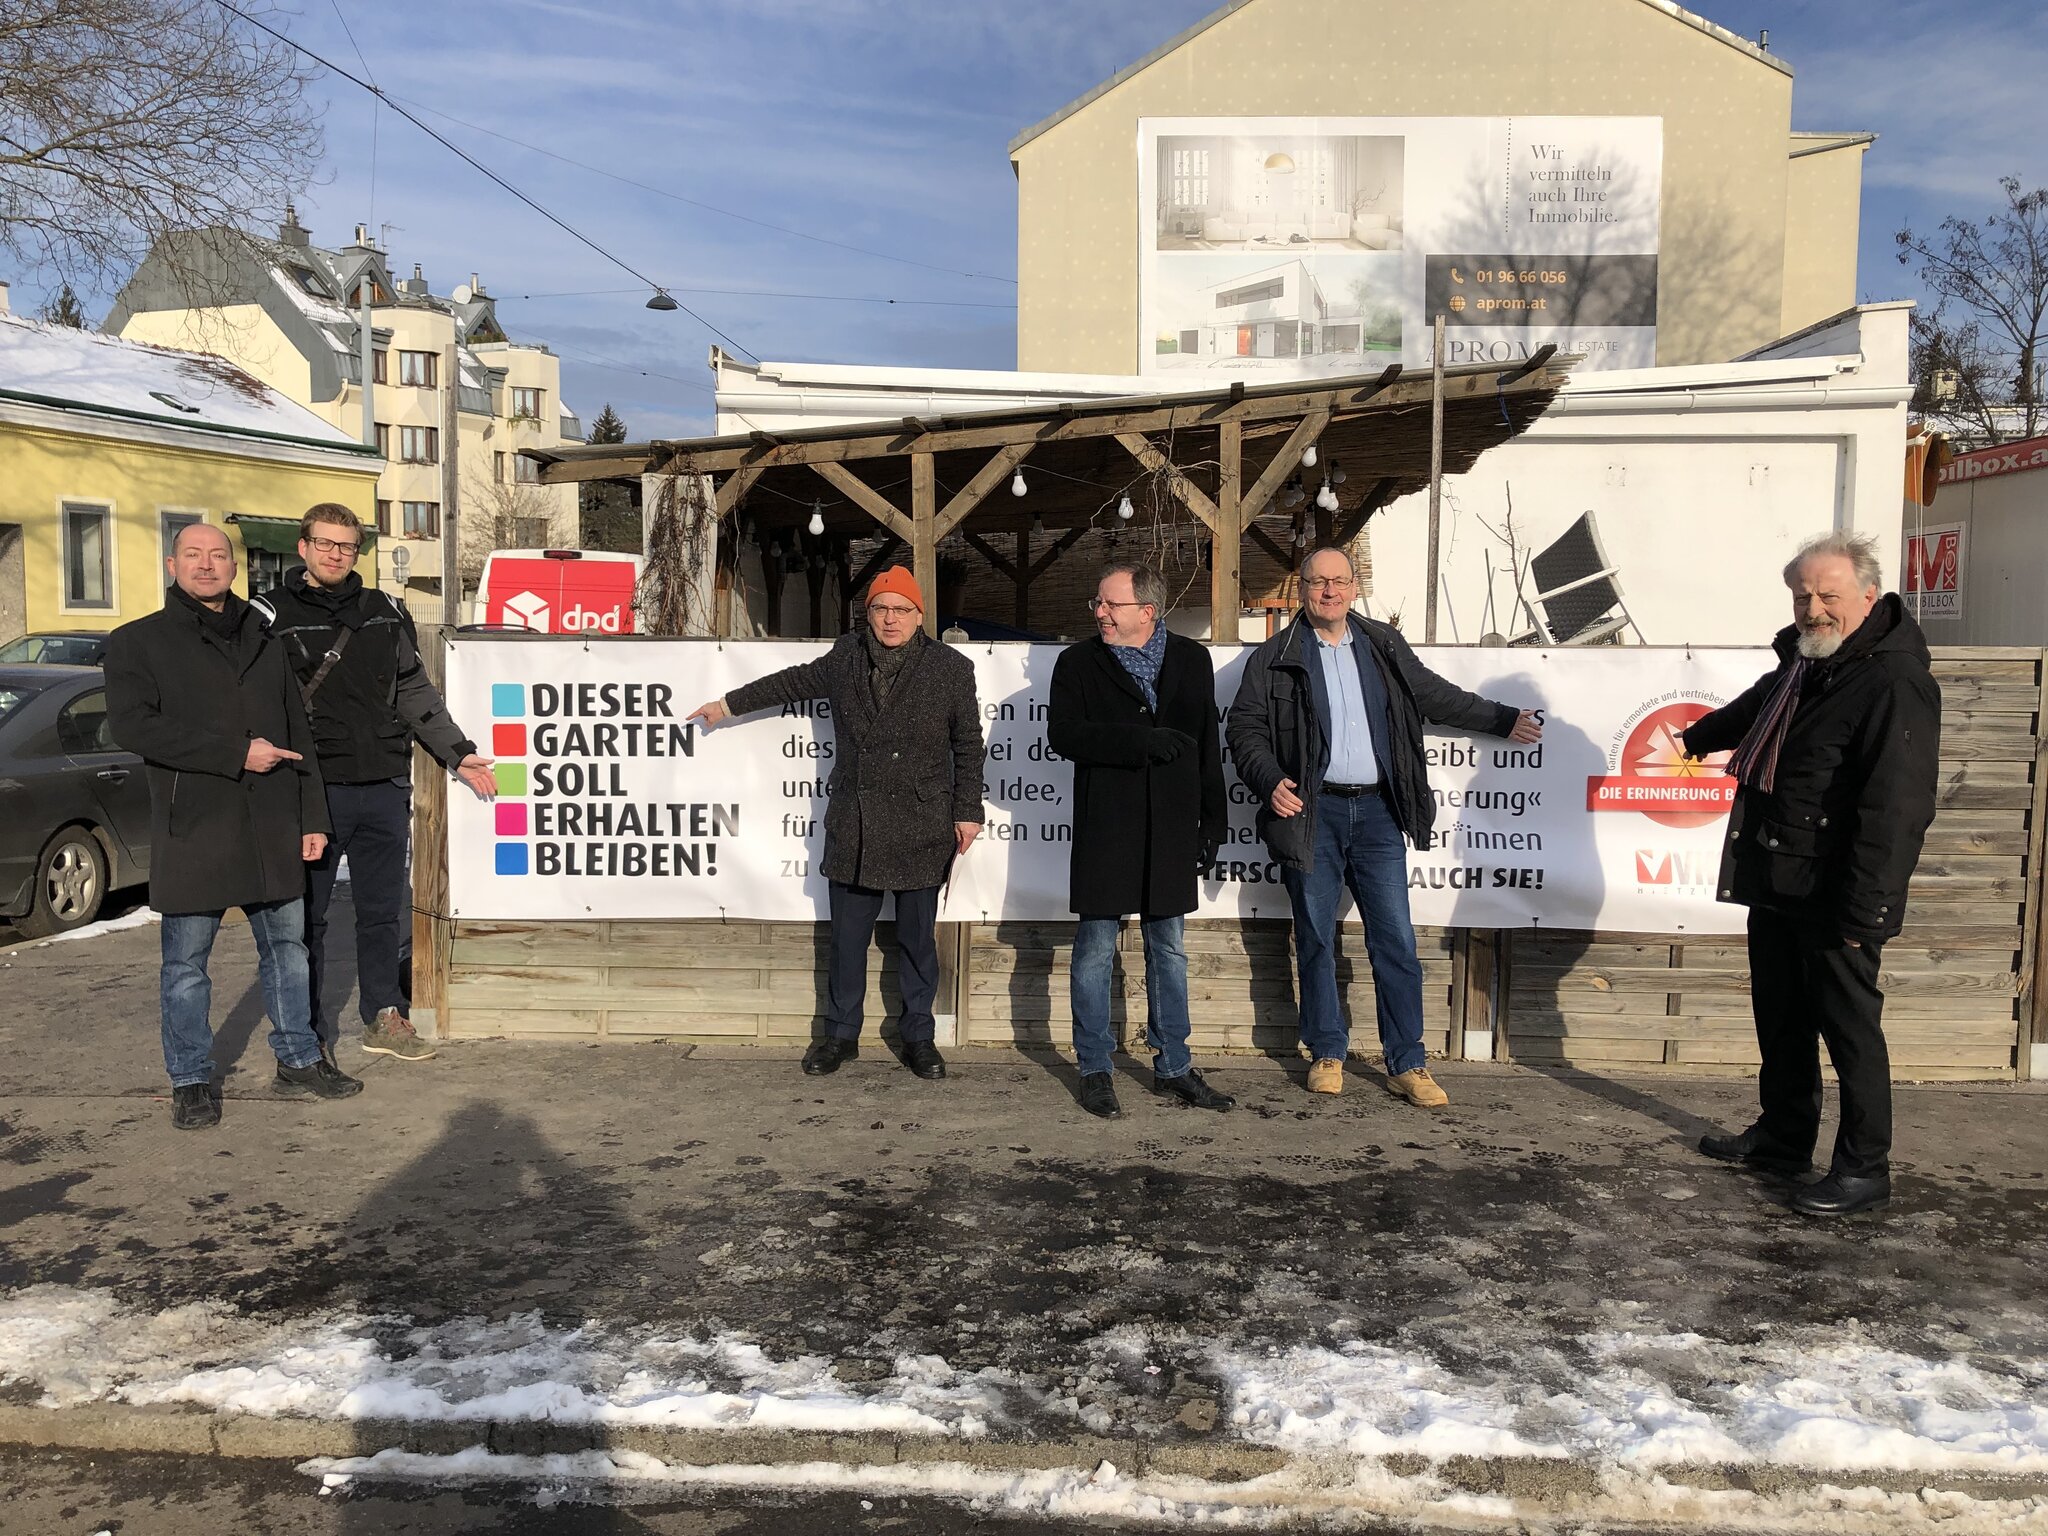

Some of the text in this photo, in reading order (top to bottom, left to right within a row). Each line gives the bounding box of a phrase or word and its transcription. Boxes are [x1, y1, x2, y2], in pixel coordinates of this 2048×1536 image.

[1531, 144, 1564, 160] Wir
[1529, 166, 1612, 181] vermitteln
[1528, 187, 1607, 202] auch Ihre
[1529, 208, 1618, 223] Immobilie.
[1476, 270, 1567, 283] 01 96 66 056
[1476, 297, 1547, 312] aprom.at
[1579, 342, 1618, 352] ESTATE
[1944, 536, 1957, 587] BOX
[562, 603, 620, 632] dpd
[532, 683, 674, 717] DIESER
[533, 723, 694, 757] GARTEN
[1607, 743, 1620, 771] Garten
[1615, 728, 1626, 742] für
[1624, 696, 1659, 729] ermordete
[1661, 689, 1678, 702] und
[782, 734, 834, 759] dies
[984, 737, 1012, 761] ei
[1028, 737, 1065, 762] de
[1493, 744, 1543, 769] und
[533, 763, 628, 797] SOLL
[1000, 777, 1062, 806] Idee,
[1600, 787, 1734, 800] DIE ERINNERUNG B
[534, 803, 739, 837] ERHALTEN
[782, 813, 817, 838] für
[535, 842, 717, 877] BLEIBEN!
[780, 859, 1544, 890] zu ERSC AUCH SIE!
